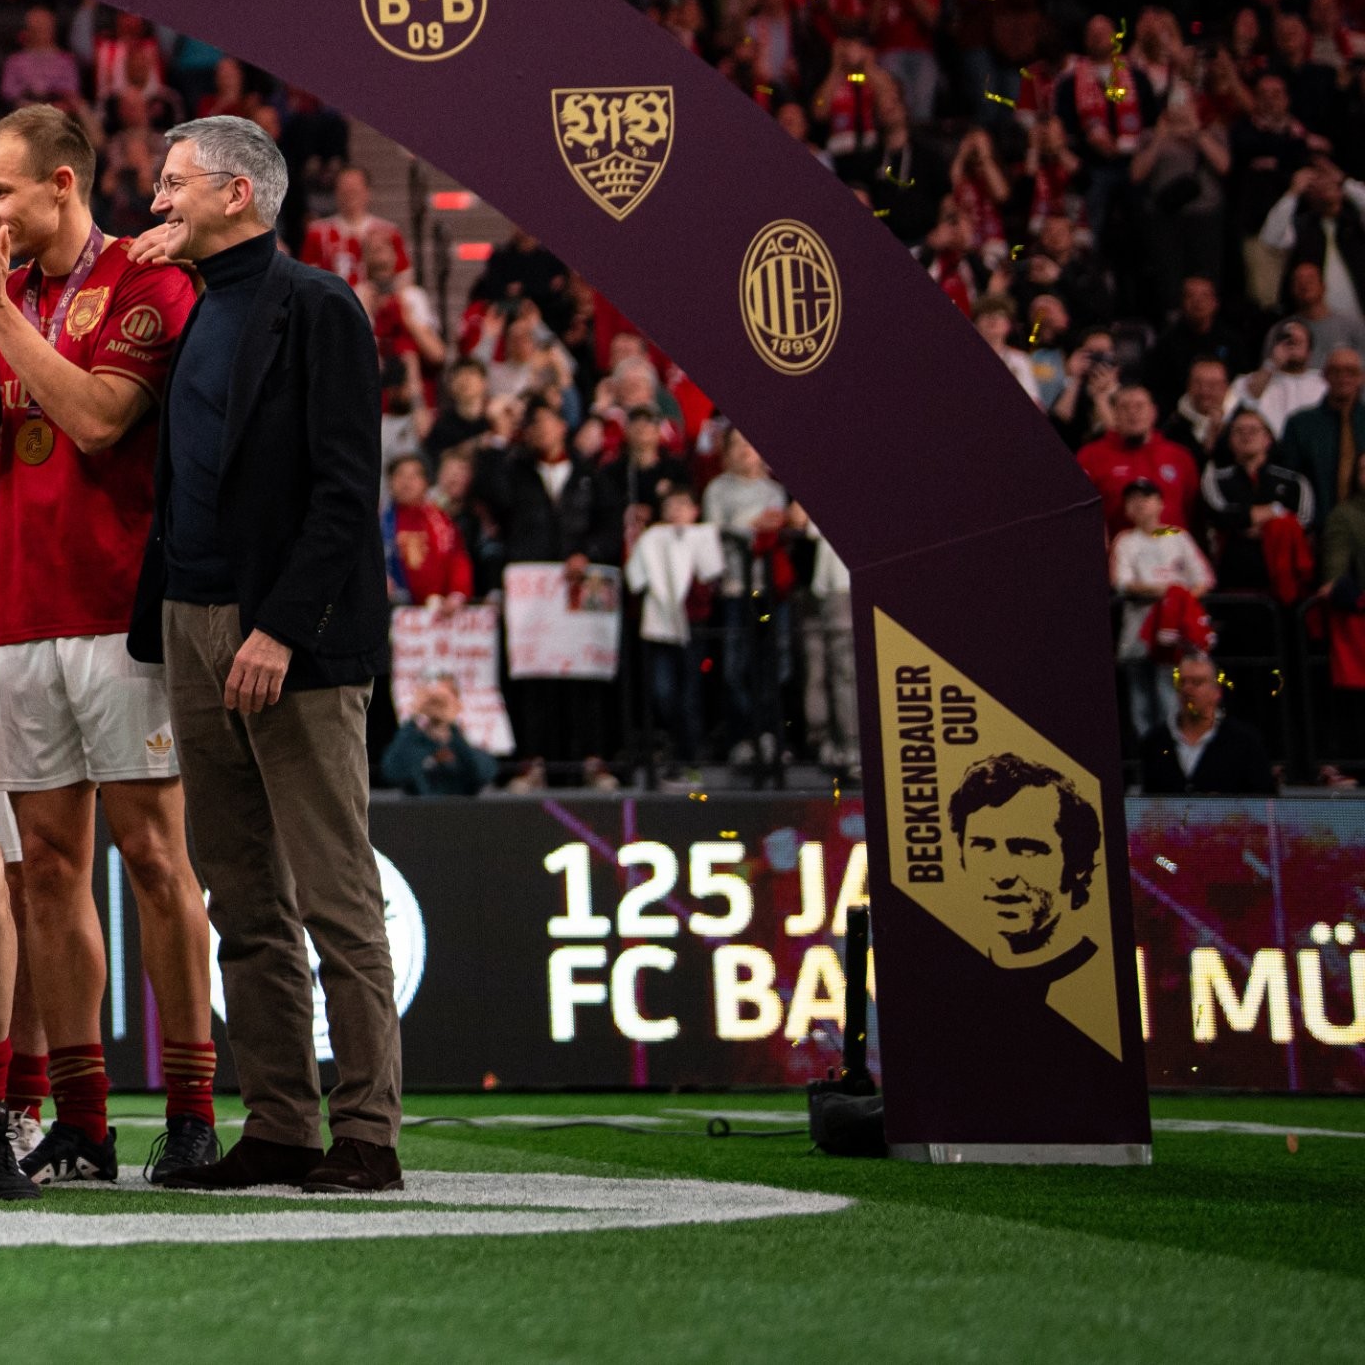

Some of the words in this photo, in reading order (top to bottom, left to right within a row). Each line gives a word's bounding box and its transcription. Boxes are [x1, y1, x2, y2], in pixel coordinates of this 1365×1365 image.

[407, 22, 445, 49] 09
[585, 146, 600, 159] 18
[632, 145, 648, 158] 93
[765, 234, 815, 258] ACM
[59, 287, 76, 309] 2025
[105, 338, 154, 364] Allianz
[770, 336, 817, 356] 1899
[941, 683, 980, 746] CUP
[895, 664, 945, 884] BECKENBAUER
[544, 841, 755, 938] 125
[547, 945, 680, 1043] FC
